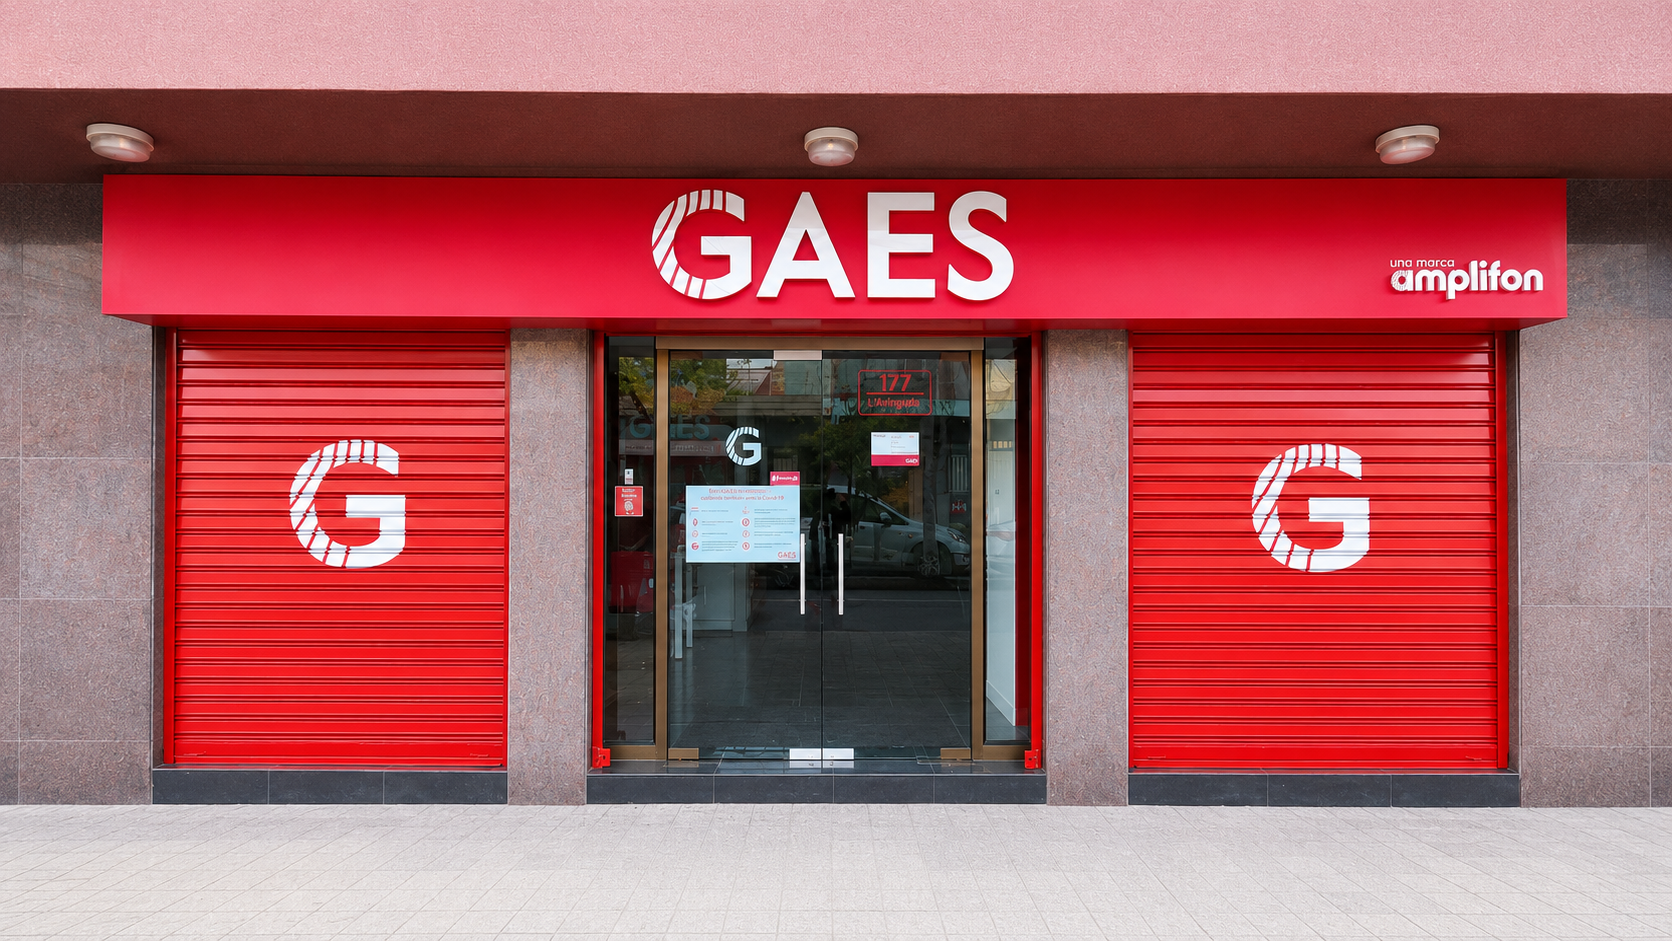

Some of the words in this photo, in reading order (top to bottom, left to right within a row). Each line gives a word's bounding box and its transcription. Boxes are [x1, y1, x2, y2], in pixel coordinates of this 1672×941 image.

[651, 189, 1014, 301] GAES
[1390, 259, 1412, 267] una
[1417, 259, 1455, 267] marca
[1390, 260, 1544, 300] amplifon
[879, 373, 912, 392] 177
[725, 426, 762, 466] G
[289, 439, 406, 568] G
[1251, 443, 1370, 572] G
[777, 551, 796, 559] GAES
